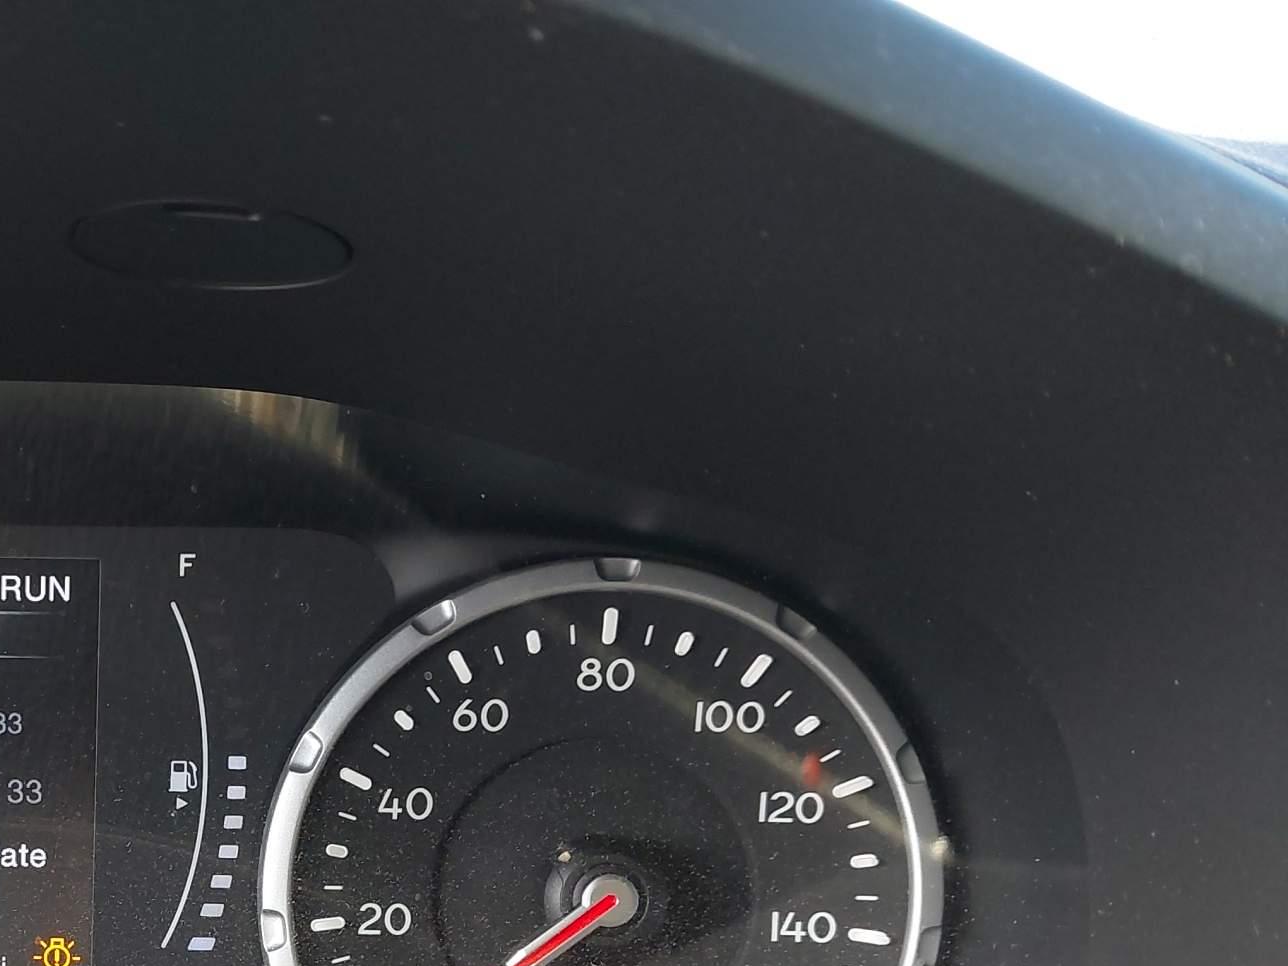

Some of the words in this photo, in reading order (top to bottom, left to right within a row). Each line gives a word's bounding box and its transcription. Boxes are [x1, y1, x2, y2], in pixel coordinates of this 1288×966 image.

[179, 554, 195, 577] F
[1, 576, 71, 601] RUN
[577, 658, 635, 691] 80
[453, 699, 510, 732] 60
[695, 700, 764, 733] 100
[8, 780, 42, 804] 33
[378, 787, 433, 820] 40
[759, 791, 823, 824] 120
[359, 904, 411, 935] 20
[771, 911, 836, 944] 140
